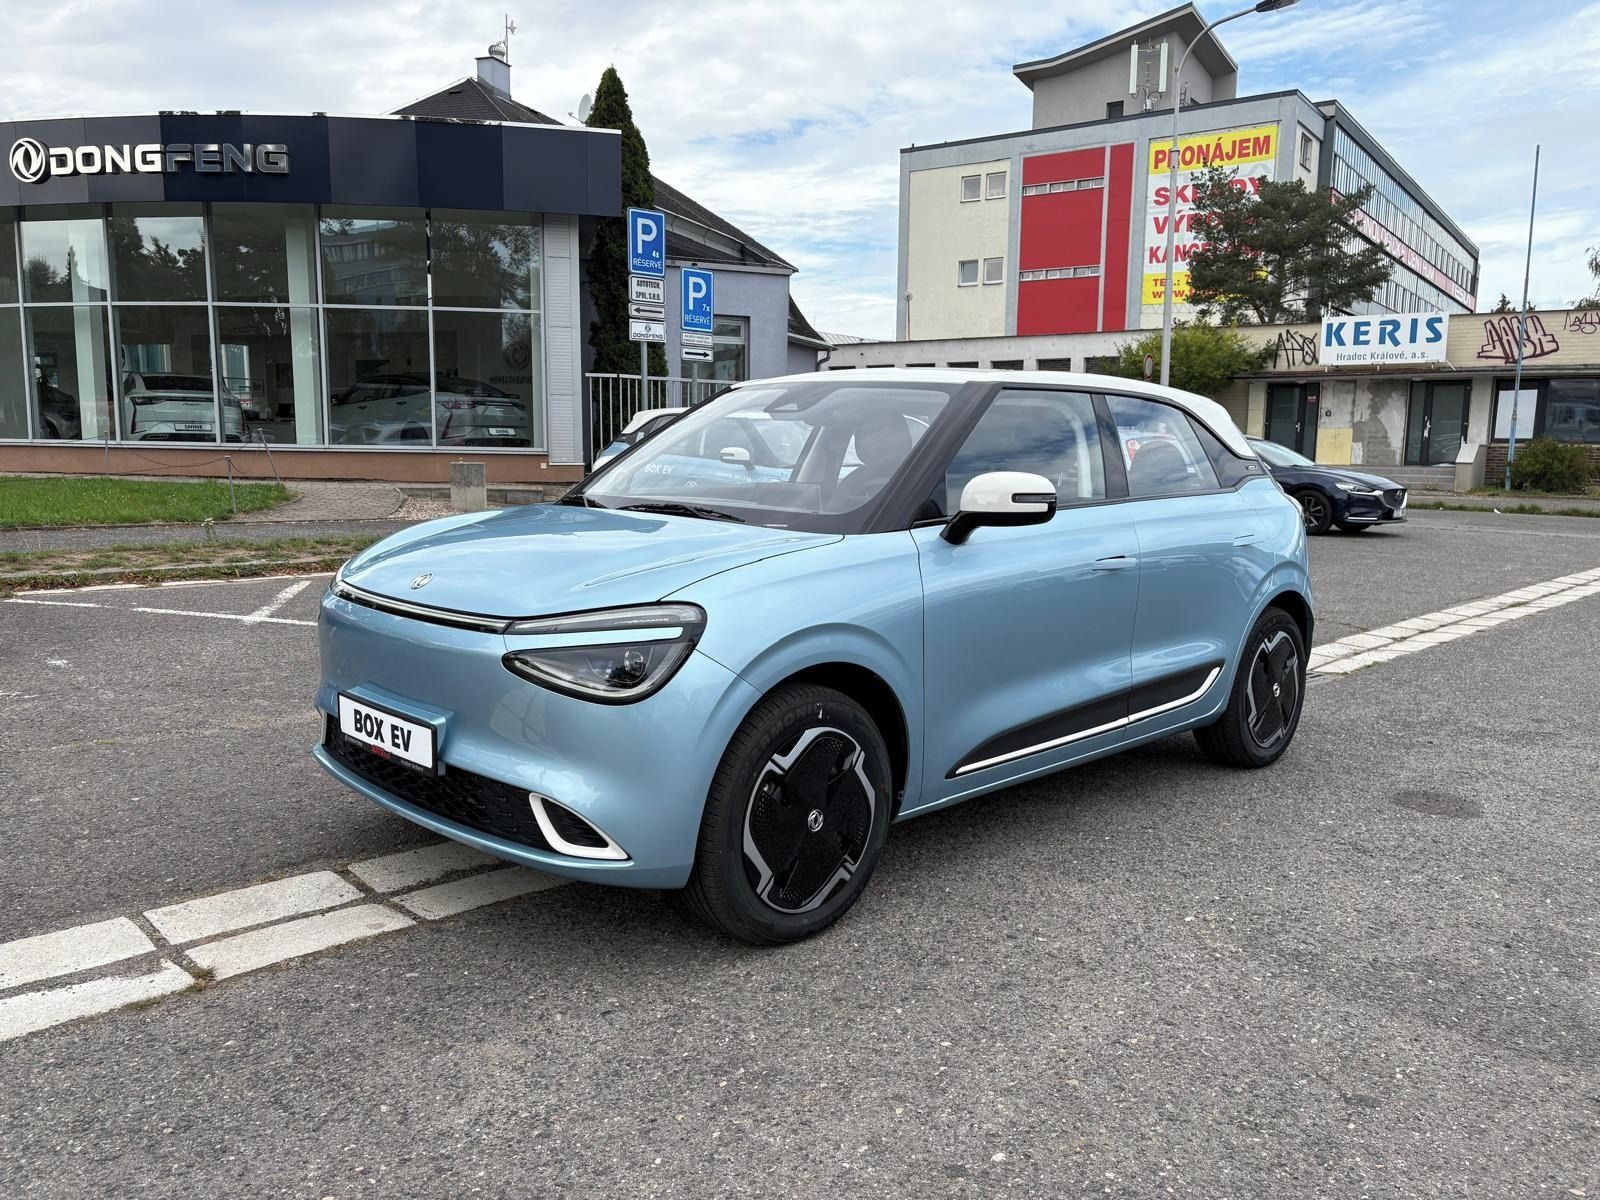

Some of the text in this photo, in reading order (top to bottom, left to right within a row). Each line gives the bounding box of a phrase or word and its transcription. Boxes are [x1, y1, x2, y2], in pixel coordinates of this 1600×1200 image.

[49, 144, 289, 175] DONGFENG
[637, 217, 658, 254] P
[633, 257, 663, 269] RÉSERVÉ
[652, 250, 660, 259] 4x
[688, 276, 707, 311] P
[684, 312, 711, 325] RÉSERVÉ
[702, 303, 711, 312] 7x
[1325, 316, 1443, 347] KERIS
[1336, 352, 1367, 361] Hradec
[1410, 351, 1429, 360] a.s.
[353, 708, 385, 743] BOX
[390, 723, 412, 753] EV
